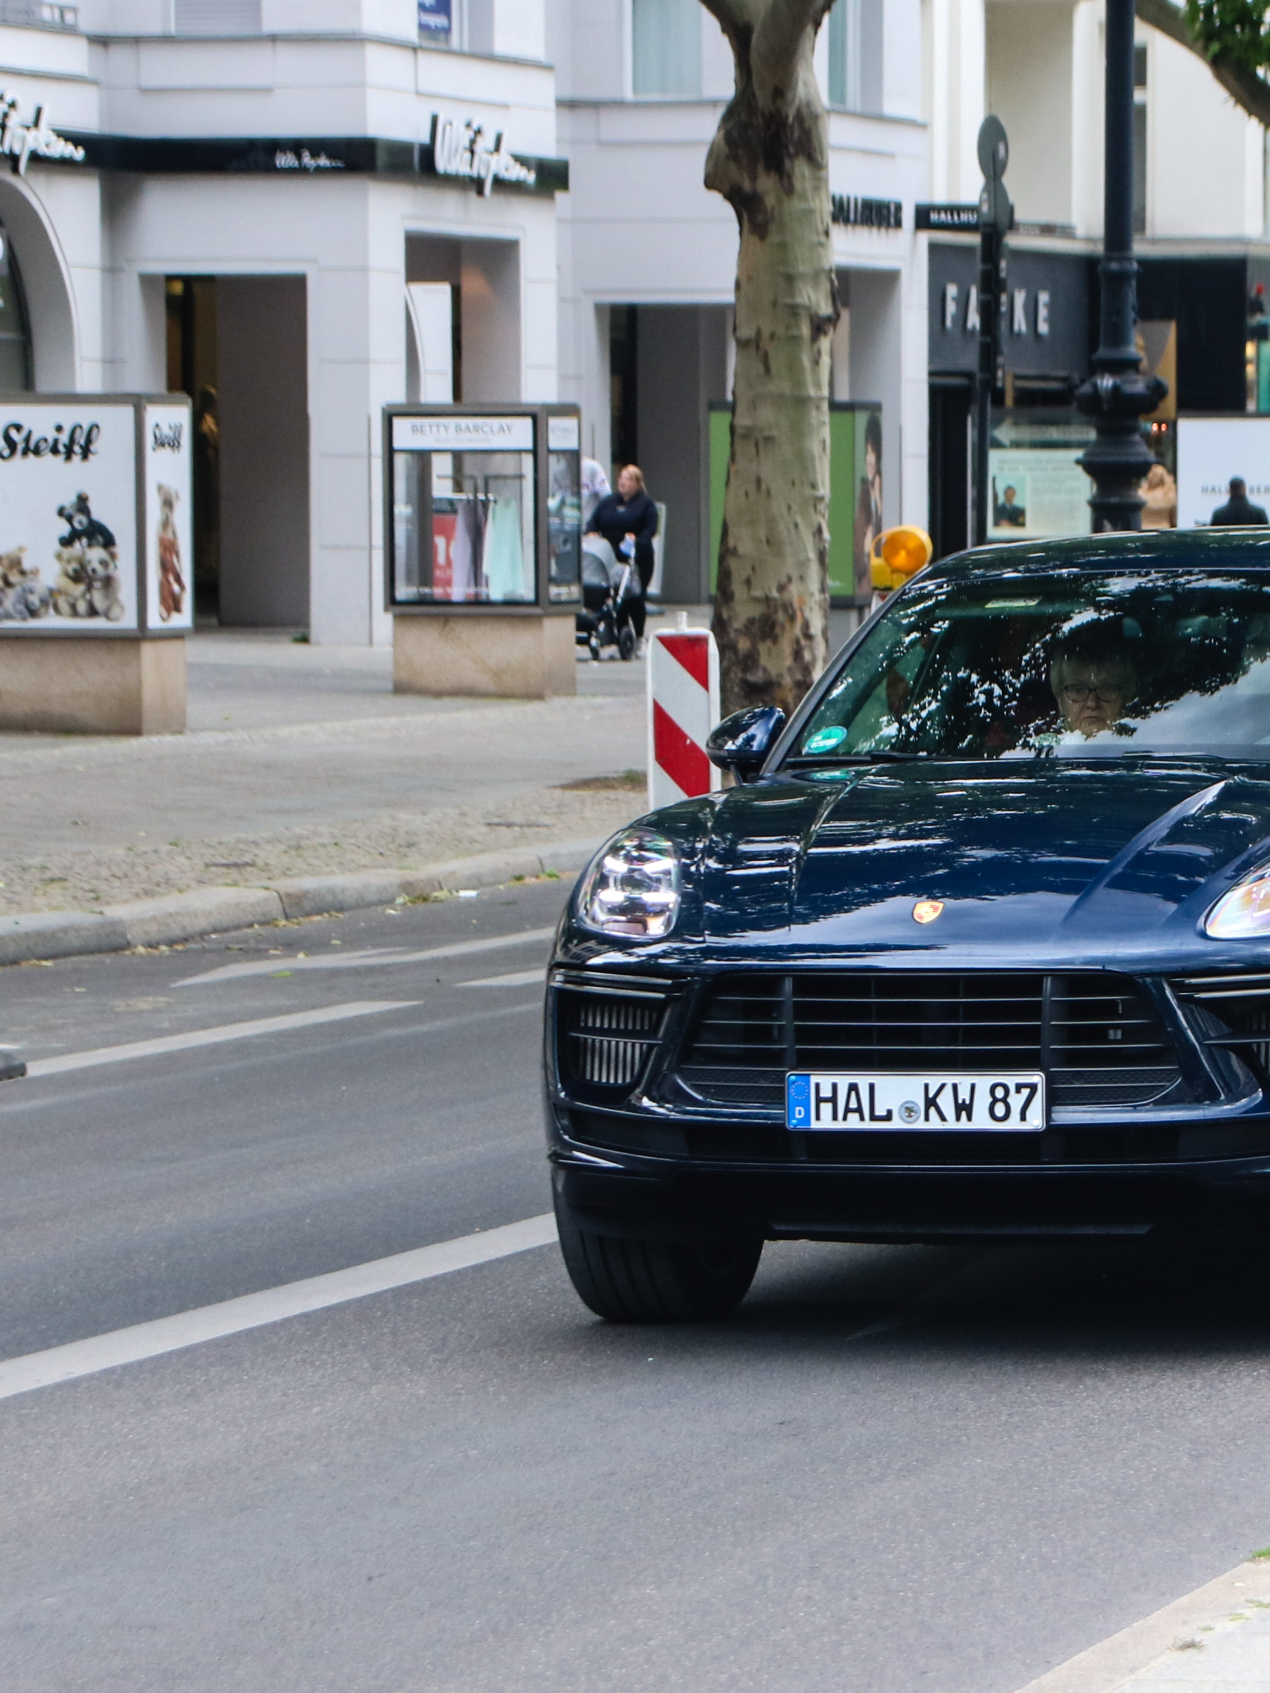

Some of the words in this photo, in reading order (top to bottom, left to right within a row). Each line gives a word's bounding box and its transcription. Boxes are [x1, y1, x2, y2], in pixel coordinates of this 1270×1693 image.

[930, 209, 978, 225] HALLHU
[945, 282, 1050, 336] FAKE
[0, 422, 100, 463] Steiff
[411, 422, 450, 436] BETTY
[455, 422, 514, 436] BARCLAY
[795, 1106, 805, 1119] D
[814, 1082, 893, 1122] HAL
[923, 1082, 976, 1122] KW
[988, 1082, 1038, 1122] 87
